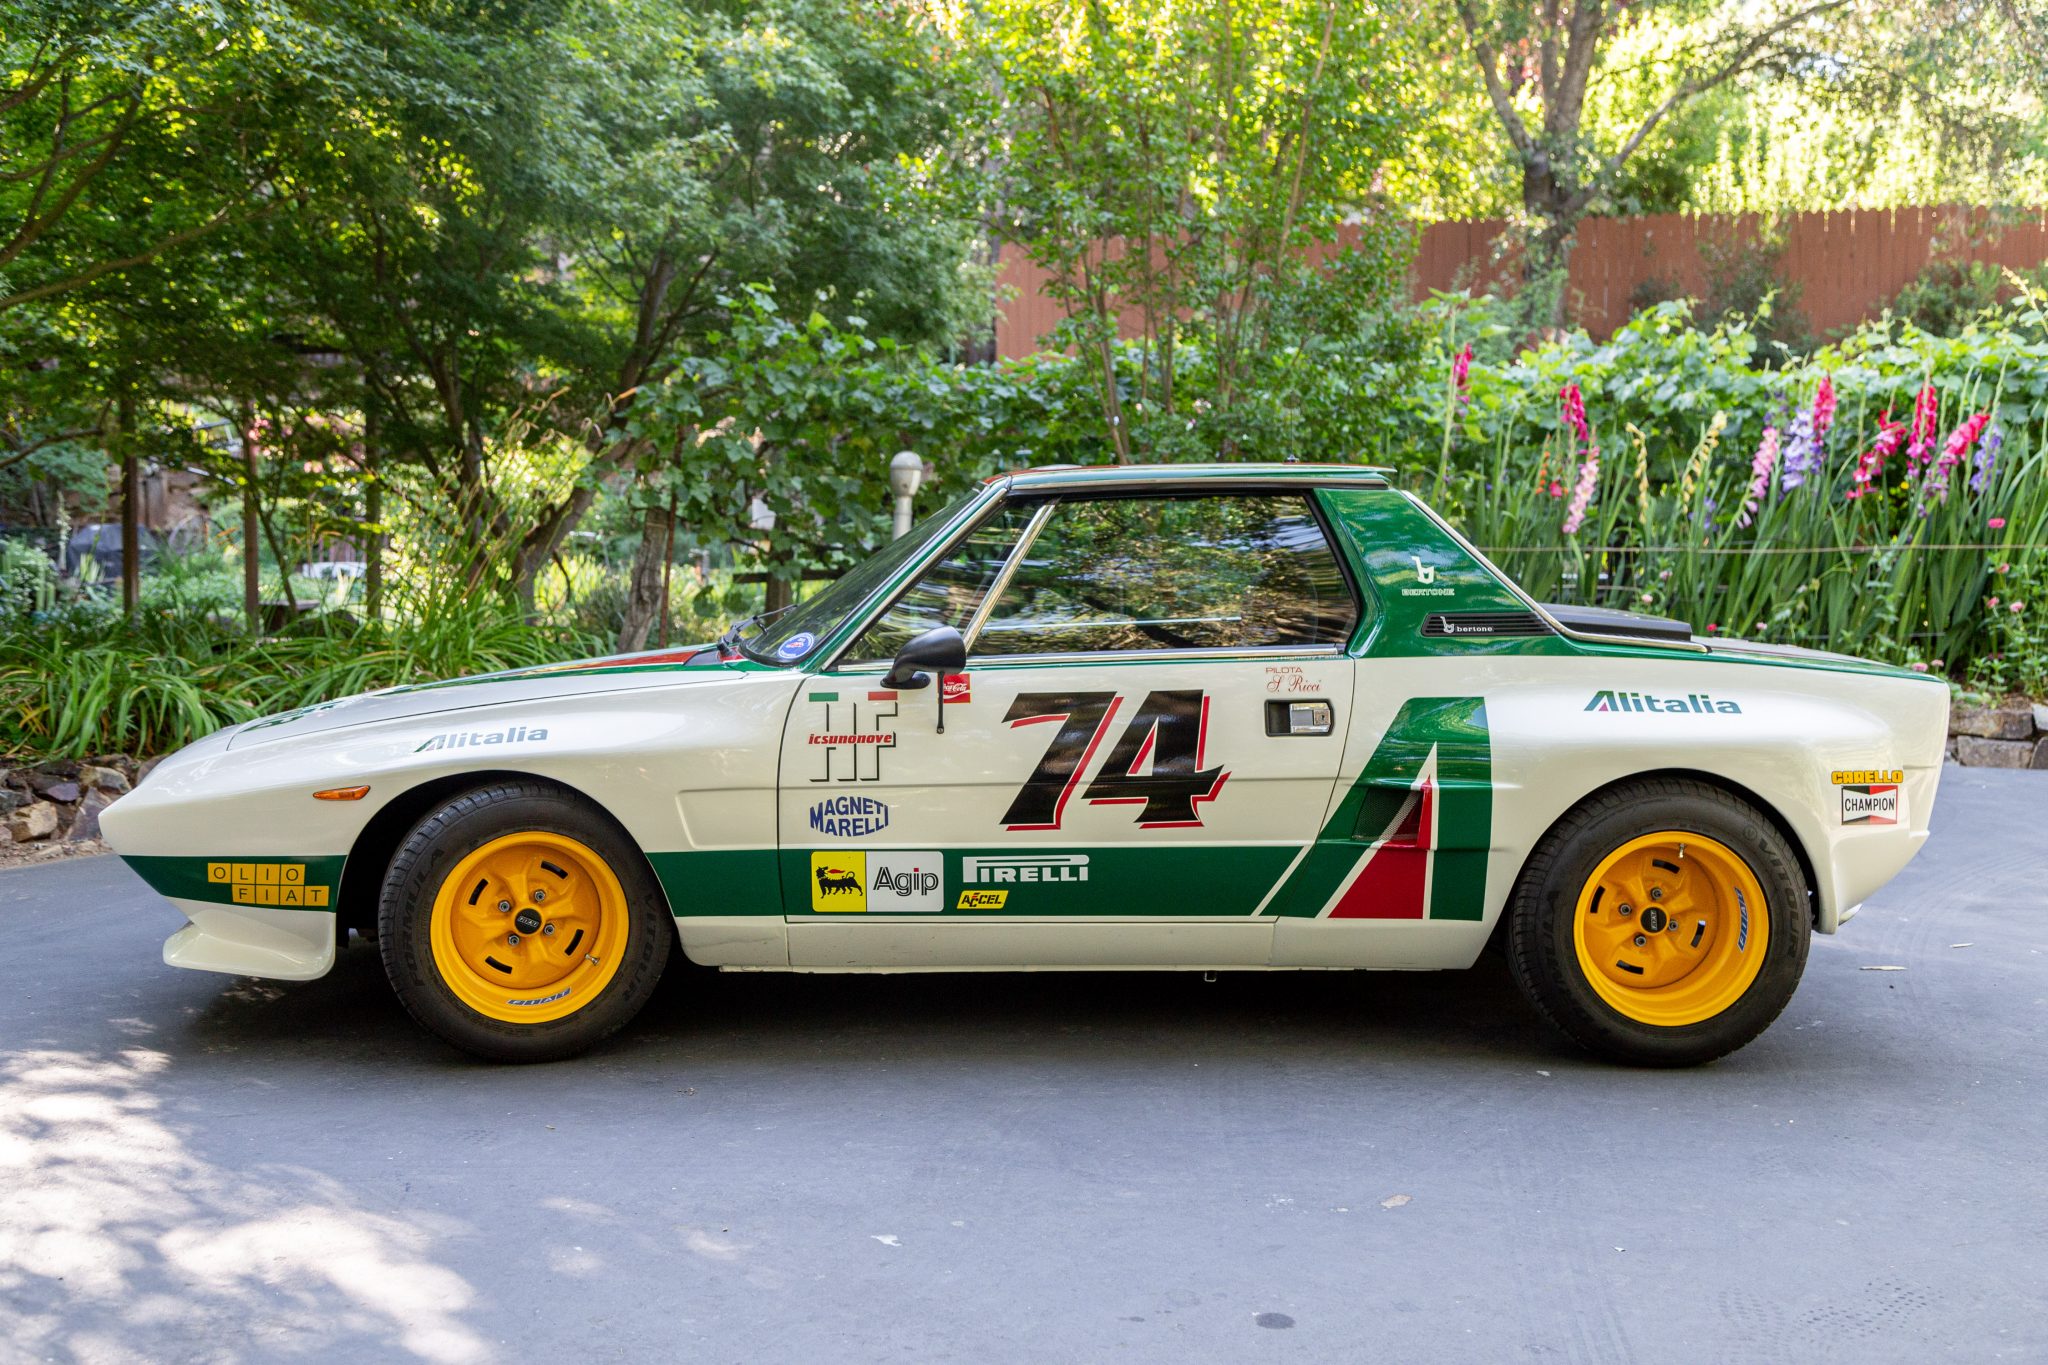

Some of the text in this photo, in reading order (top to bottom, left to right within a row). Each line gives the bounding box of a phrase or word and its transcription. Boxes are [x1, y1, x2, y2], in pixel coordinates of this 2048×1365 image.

[1402, 588, 1455, 596] BERTONE
[1288, 675, 1321, 692] Ricci
[1584, 690, 1743, 714] Alitalia
[414, 726, 549, 753] Alitalia
[809, 734, 892, 744] icsunonove
[999, 689, 1233, 831] 74
[1831, 770, 1904, 785] CARELLO
[810, 796, 889, 832] MAGNETI
[1844, 798, 1895, 811] CHAMPION
[810, 802, 889, 837] MARELLI
[213, 866, 299, 881] OLIO
[962, 854, 1090, 883] PIRELLI
[873, 866, 939, 897] Agip
[238, 888, 322, 902] FIAT
[960, 892, 1003, 908] ACCEL
[1758, 837, 1799, 959] VITOUR
